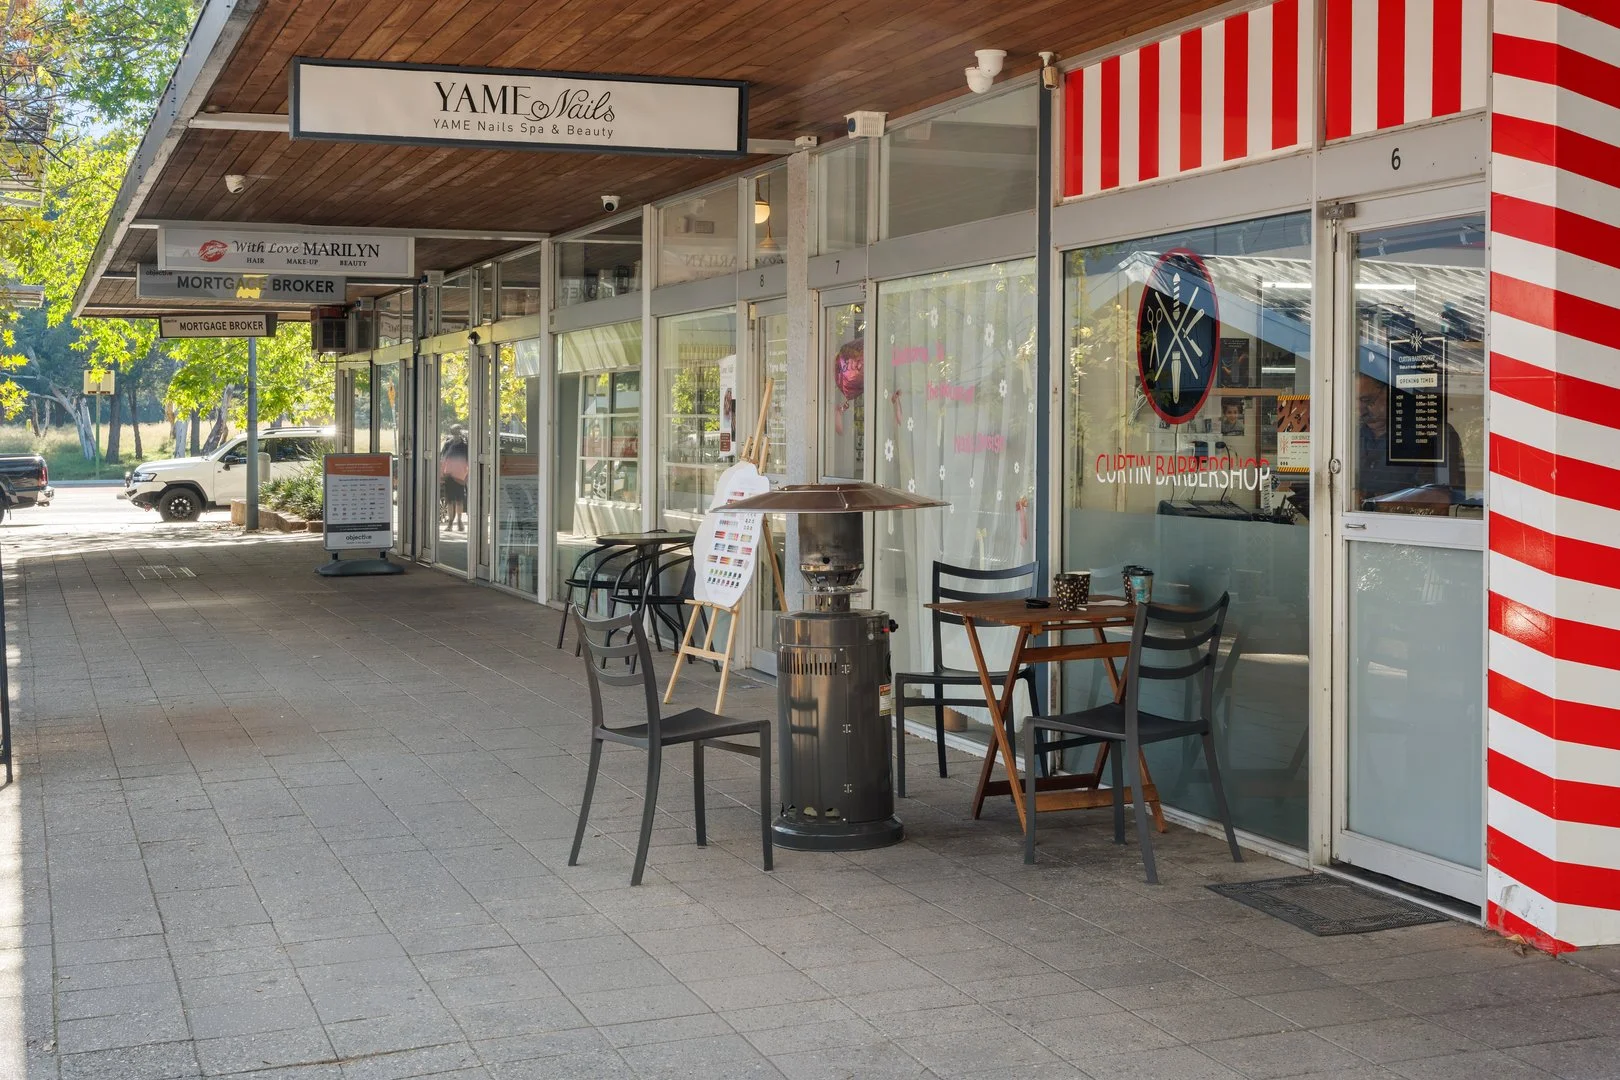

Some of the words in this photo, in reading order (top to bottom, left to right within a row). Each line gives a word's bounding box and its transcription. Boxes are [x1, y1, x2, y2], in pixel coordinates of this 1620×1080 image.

[433, 81, 531, 116] YAME
[524, 89, 615, 122] Nails
[433, 119, 471, 130] YAME
[477, 121, 514, 132] Nails
[520, 123, 544, 136] Spa
[551, 125, 560, 135] &
[567, 125, 614, 138] Beauty
[1392, 148, 1401, 170] 6
[232, 240, 266, 253] With
[267, 242, 299, 254] Love
[302, 242, 380, 258] MARILYN
[835, 260, 840, 275] 7
[177, 276, 268, 291] MORTGAGE
[272, 279, 334, 294] BROKER
[759, 274, 765, 288] 8
[180, 322, 227, 331] MORTGAGE
[230, 321, 264, 330] BROKER
[1096, 454, 1151, 485] CURTIN
[1156, 455, 1271, 492] BARBERSHOP
